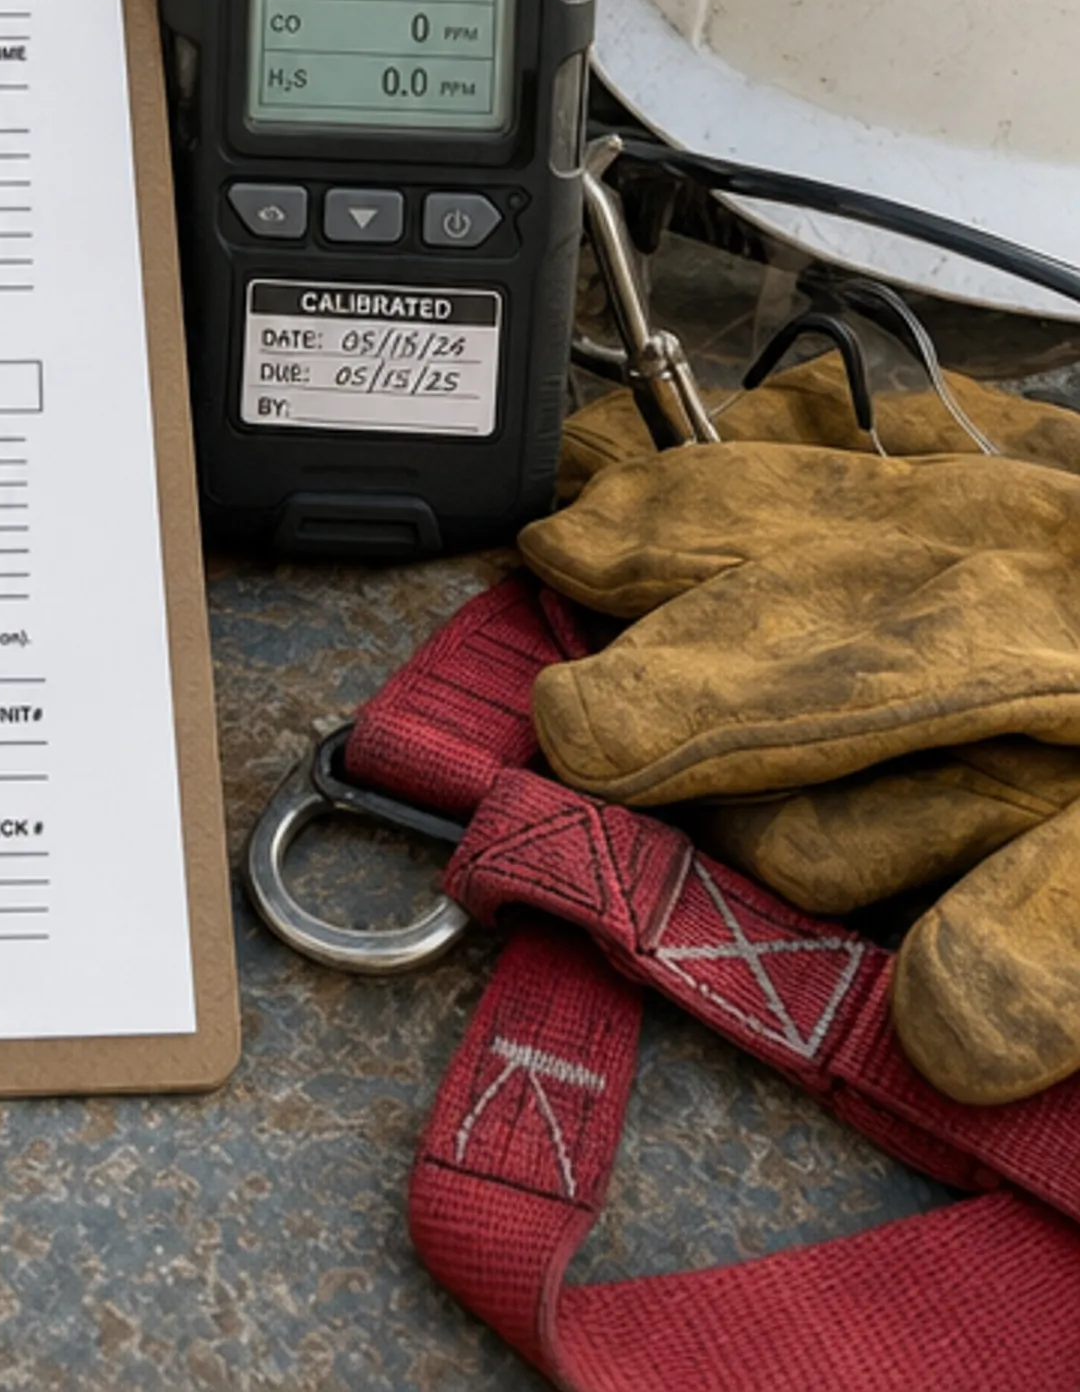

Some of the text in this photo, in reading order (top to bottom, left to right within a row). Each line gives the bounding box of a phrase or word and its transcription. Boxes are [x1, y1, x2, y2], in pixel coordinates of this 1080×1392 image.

[270, 13, 478, 43] CO 0 PPM
[382, 67, 428, 98] 0.0
[440, 81, 476, 96] PPM
[302, 293, 452, 320] CALIBRATED
[262, 329, 322, 349] DATE:
[260, 363, 309, 382] DUE:
[335, 360, 460, 394] 05/15/25
[258, 397, 290, 417] BY:
